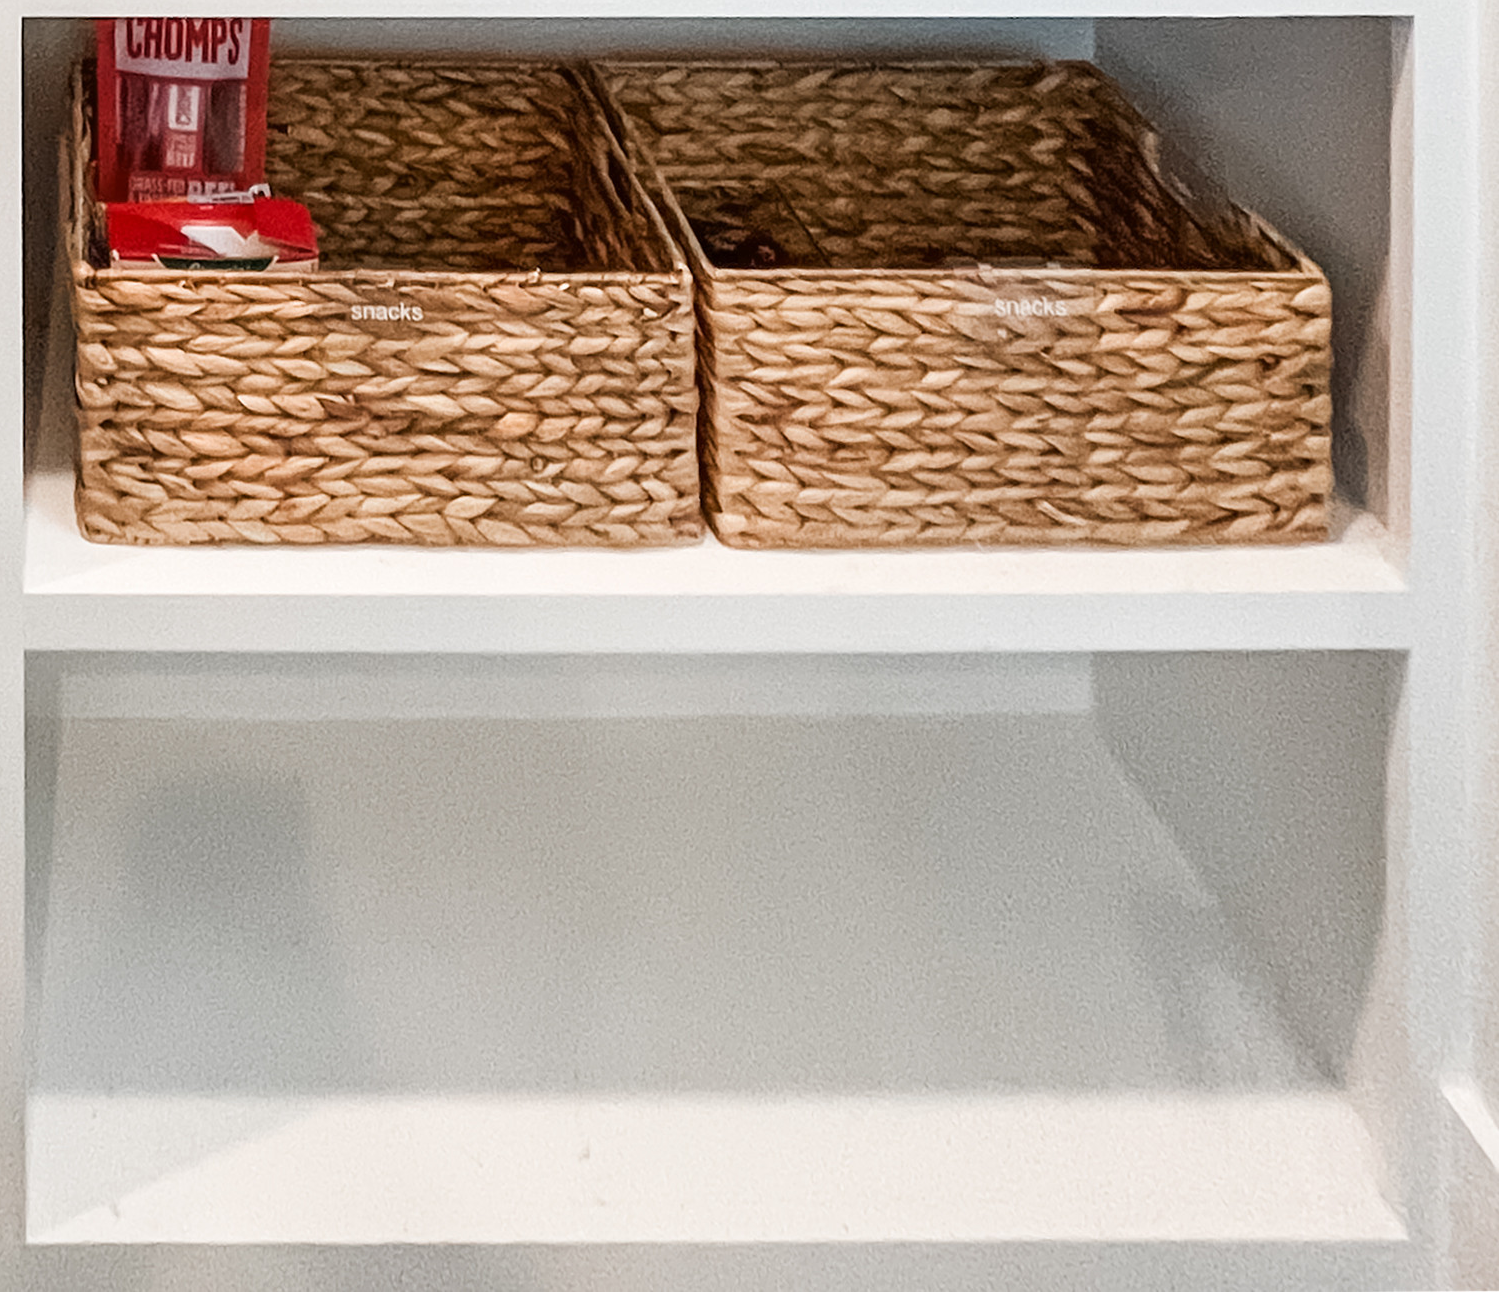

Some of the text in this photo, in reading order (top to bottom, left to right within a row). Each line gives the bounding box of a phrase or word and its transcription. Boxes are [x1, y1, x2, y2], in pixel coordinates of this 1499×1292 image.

[126, 17, 243, 65] CHOMPS
[350, 303, 423, 321] snacks
[994, 297, 1067, 317] snacks
